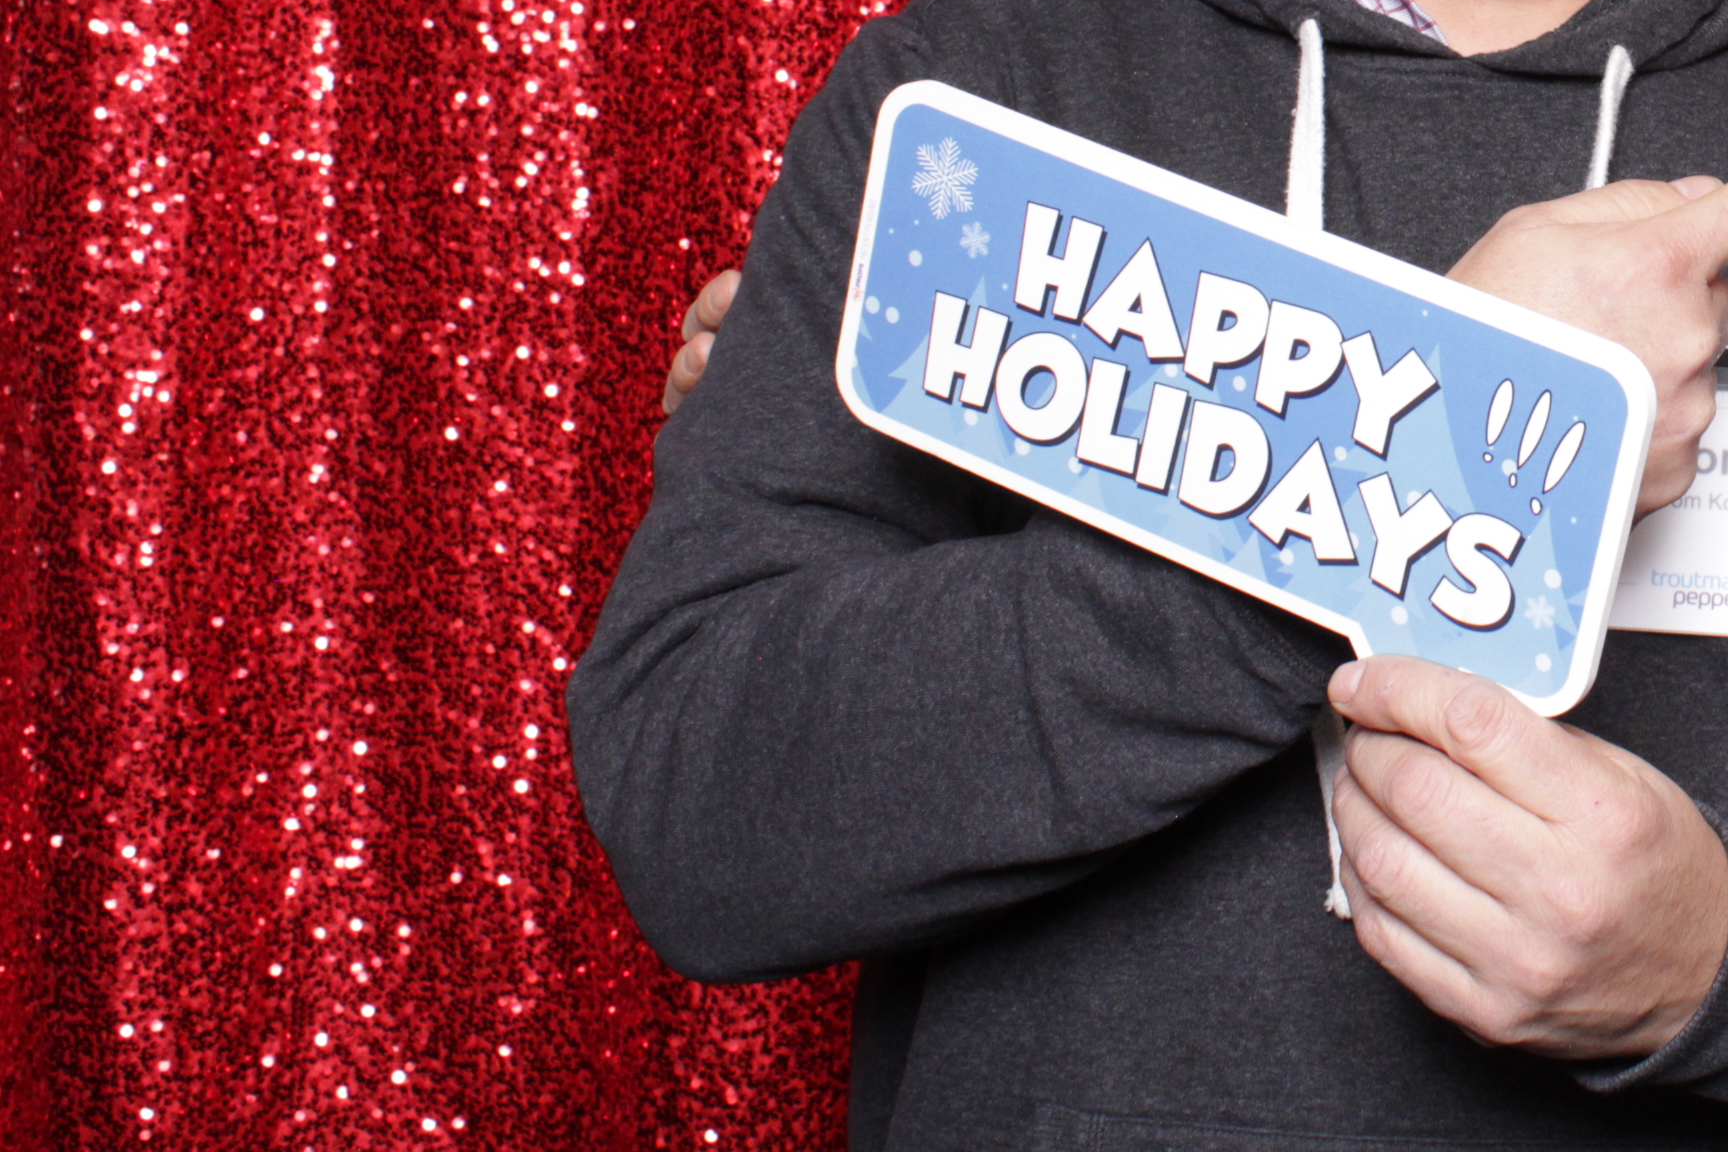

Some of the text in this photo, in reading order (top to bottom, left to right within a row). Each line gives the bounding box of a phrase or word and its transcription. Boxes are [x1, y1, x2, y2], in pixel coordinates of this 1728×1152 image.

[1012, 199, 1441, 457] HAPPY
[922, 290, 1525, 631] HOLIDAYS
[1671, 494, 1701, 509] om
